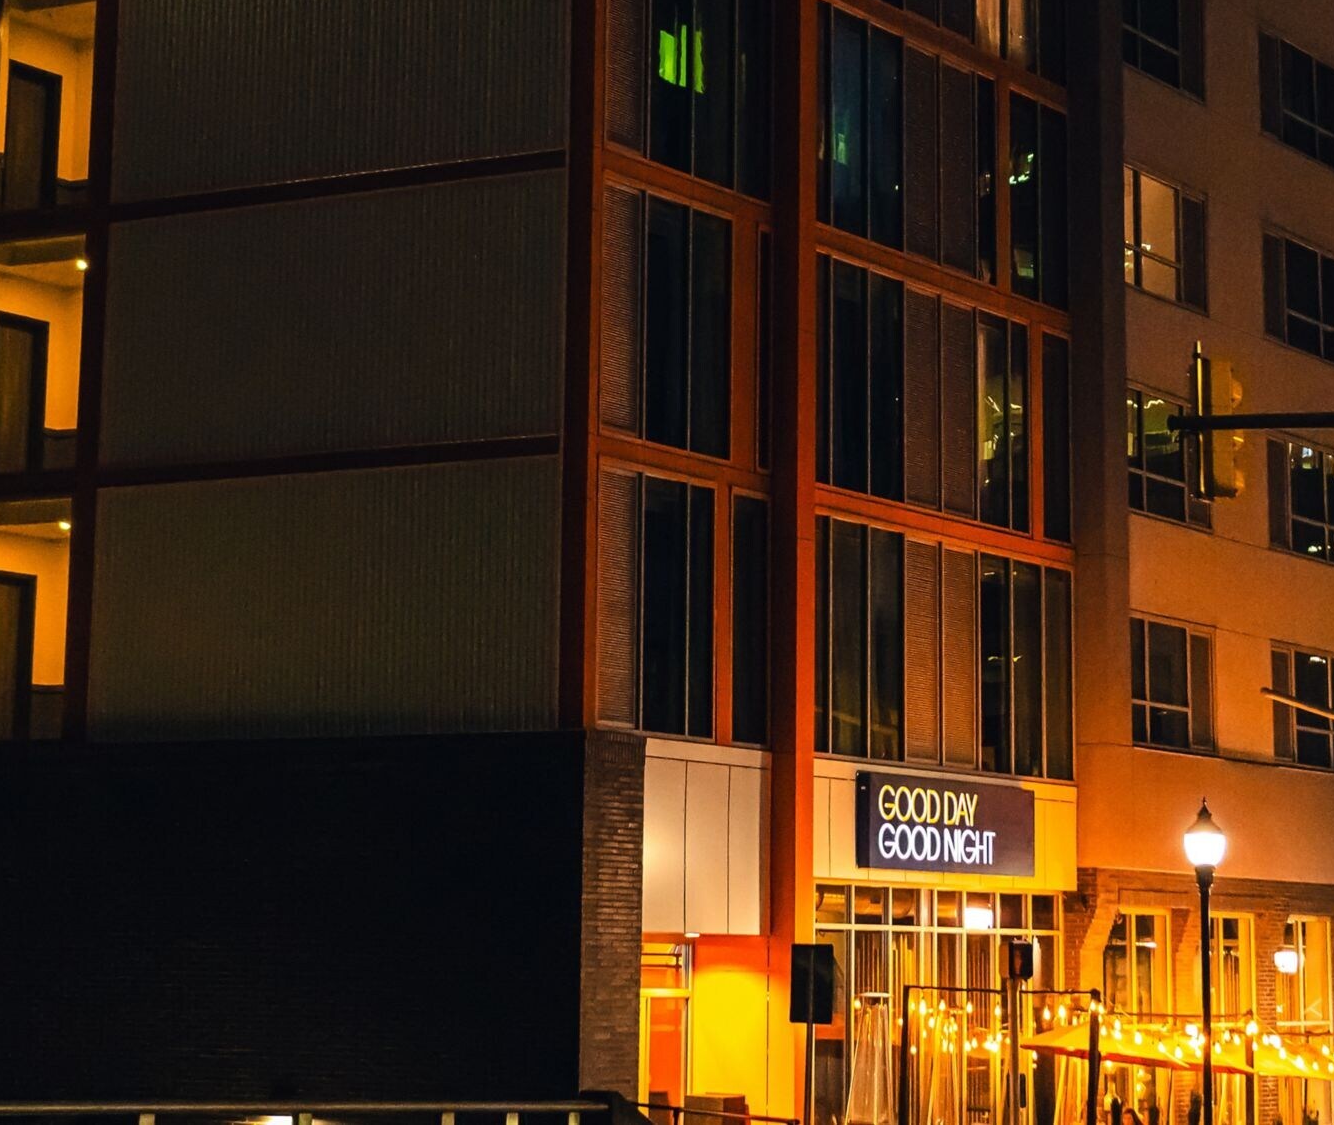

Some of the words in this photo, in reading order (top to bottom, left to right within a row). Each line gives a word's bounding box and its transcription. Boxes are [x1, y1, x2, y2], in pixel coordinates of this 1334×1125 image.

[878, 784, 941, 825] GOOD
[943, 790, 979, 827] DAY
[878, 822, 941, 861] GOOD
[943, 828, 996, 865] NIGHT
